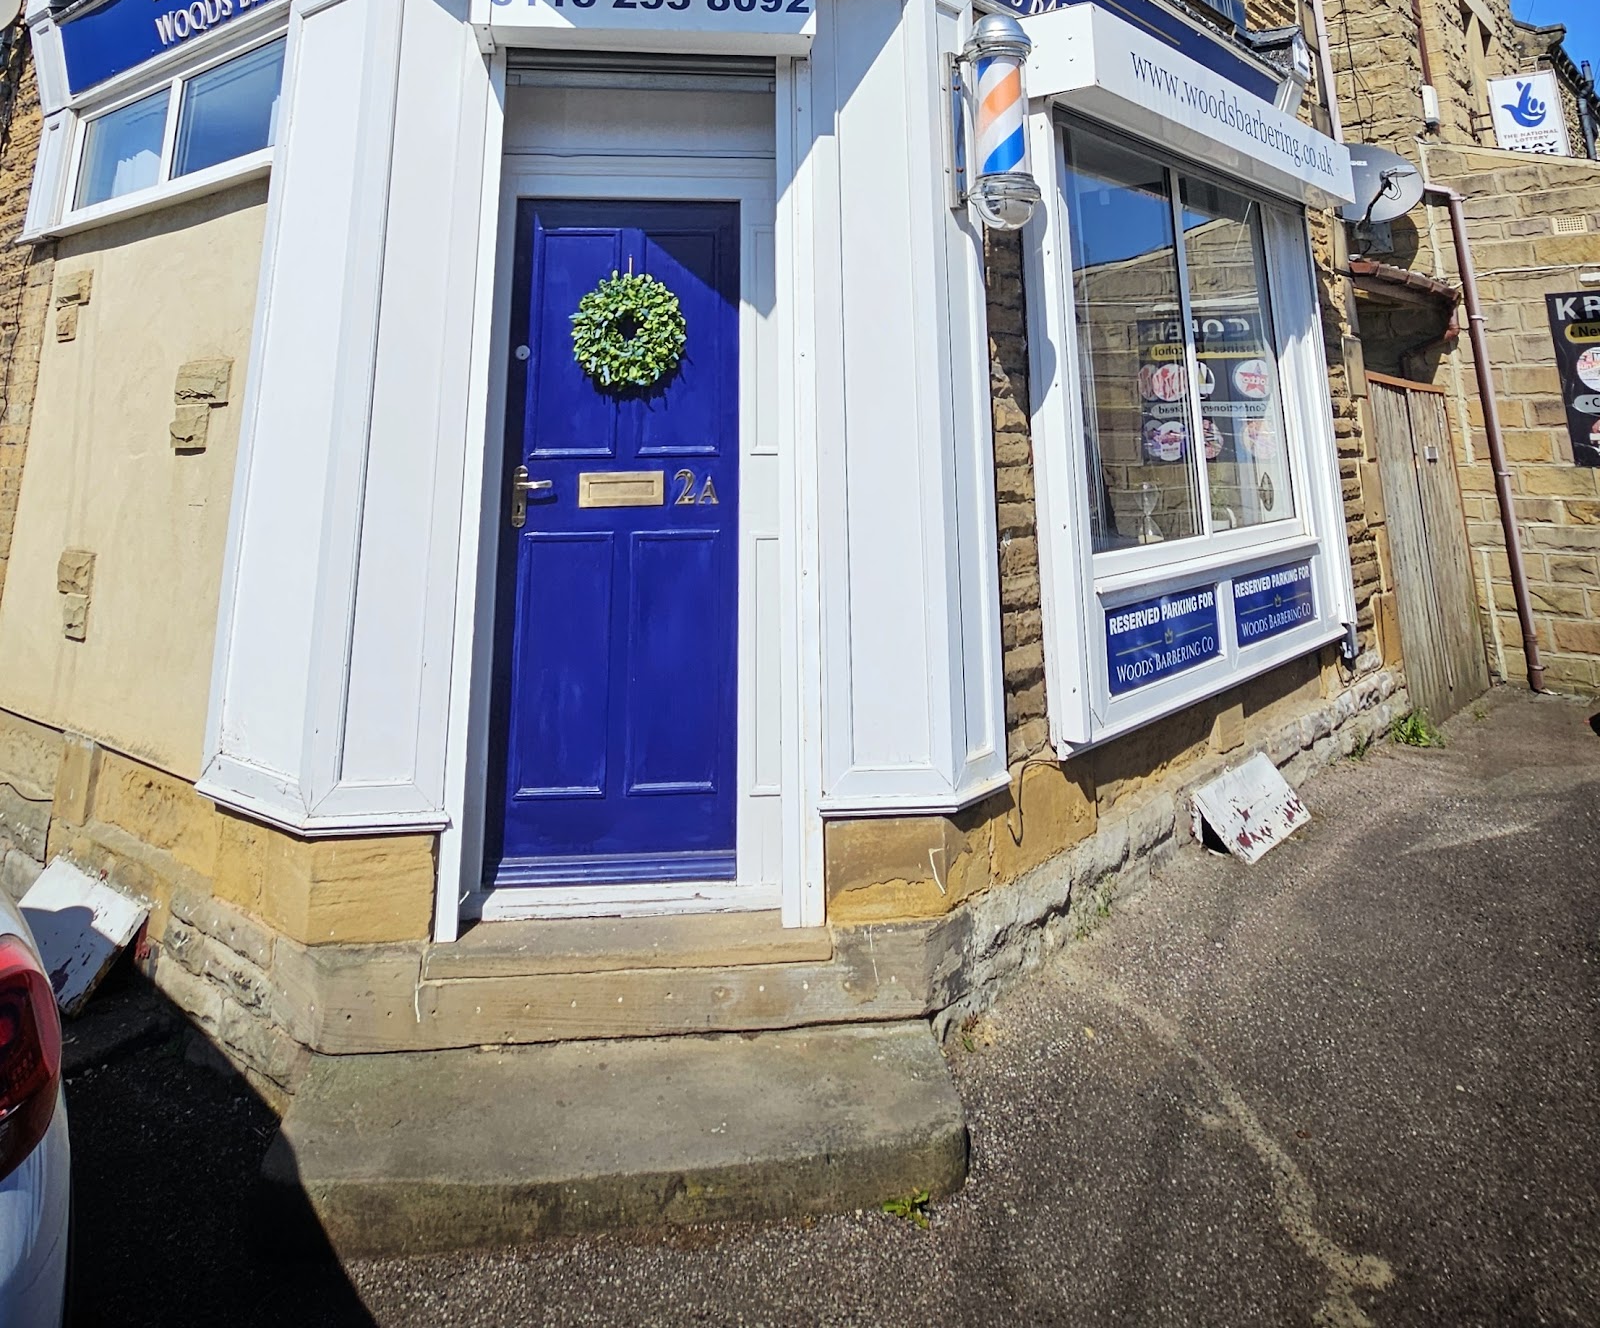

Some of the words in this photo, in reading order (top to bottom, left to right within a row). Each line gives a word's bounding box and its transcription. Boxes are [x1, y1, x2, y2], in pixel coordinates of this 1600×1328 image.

[1130, 51, 1334, 177] www.woodsbarbering.co.uk
[1515, 134, 1549, 143] LOTTERY
[1520, 128, 1559, 137] NATIONAL
[673, 468, 719, 505] 2A
[1234, 575, 1271, 598] RESERVED
[1272, 568, 1298, 588] PARKING
[1297, 565, 1310, 582] FOR
[1109, 608, 1160, 636] RESERVED
[1161, 597, 1198, 622] PARKING
[1198, 591, 1214, 609] FOR
[1241, 617, 1268, 637] WOODS
[1268, 605, 1302, 628] BARBERING
[1301, 602, 1312, 617] CO
[1116, 657, 1154, 684] WOODS
[1155, 642, 1201, 668] BARBERING
[1201, 635, 1214, 653] CO
